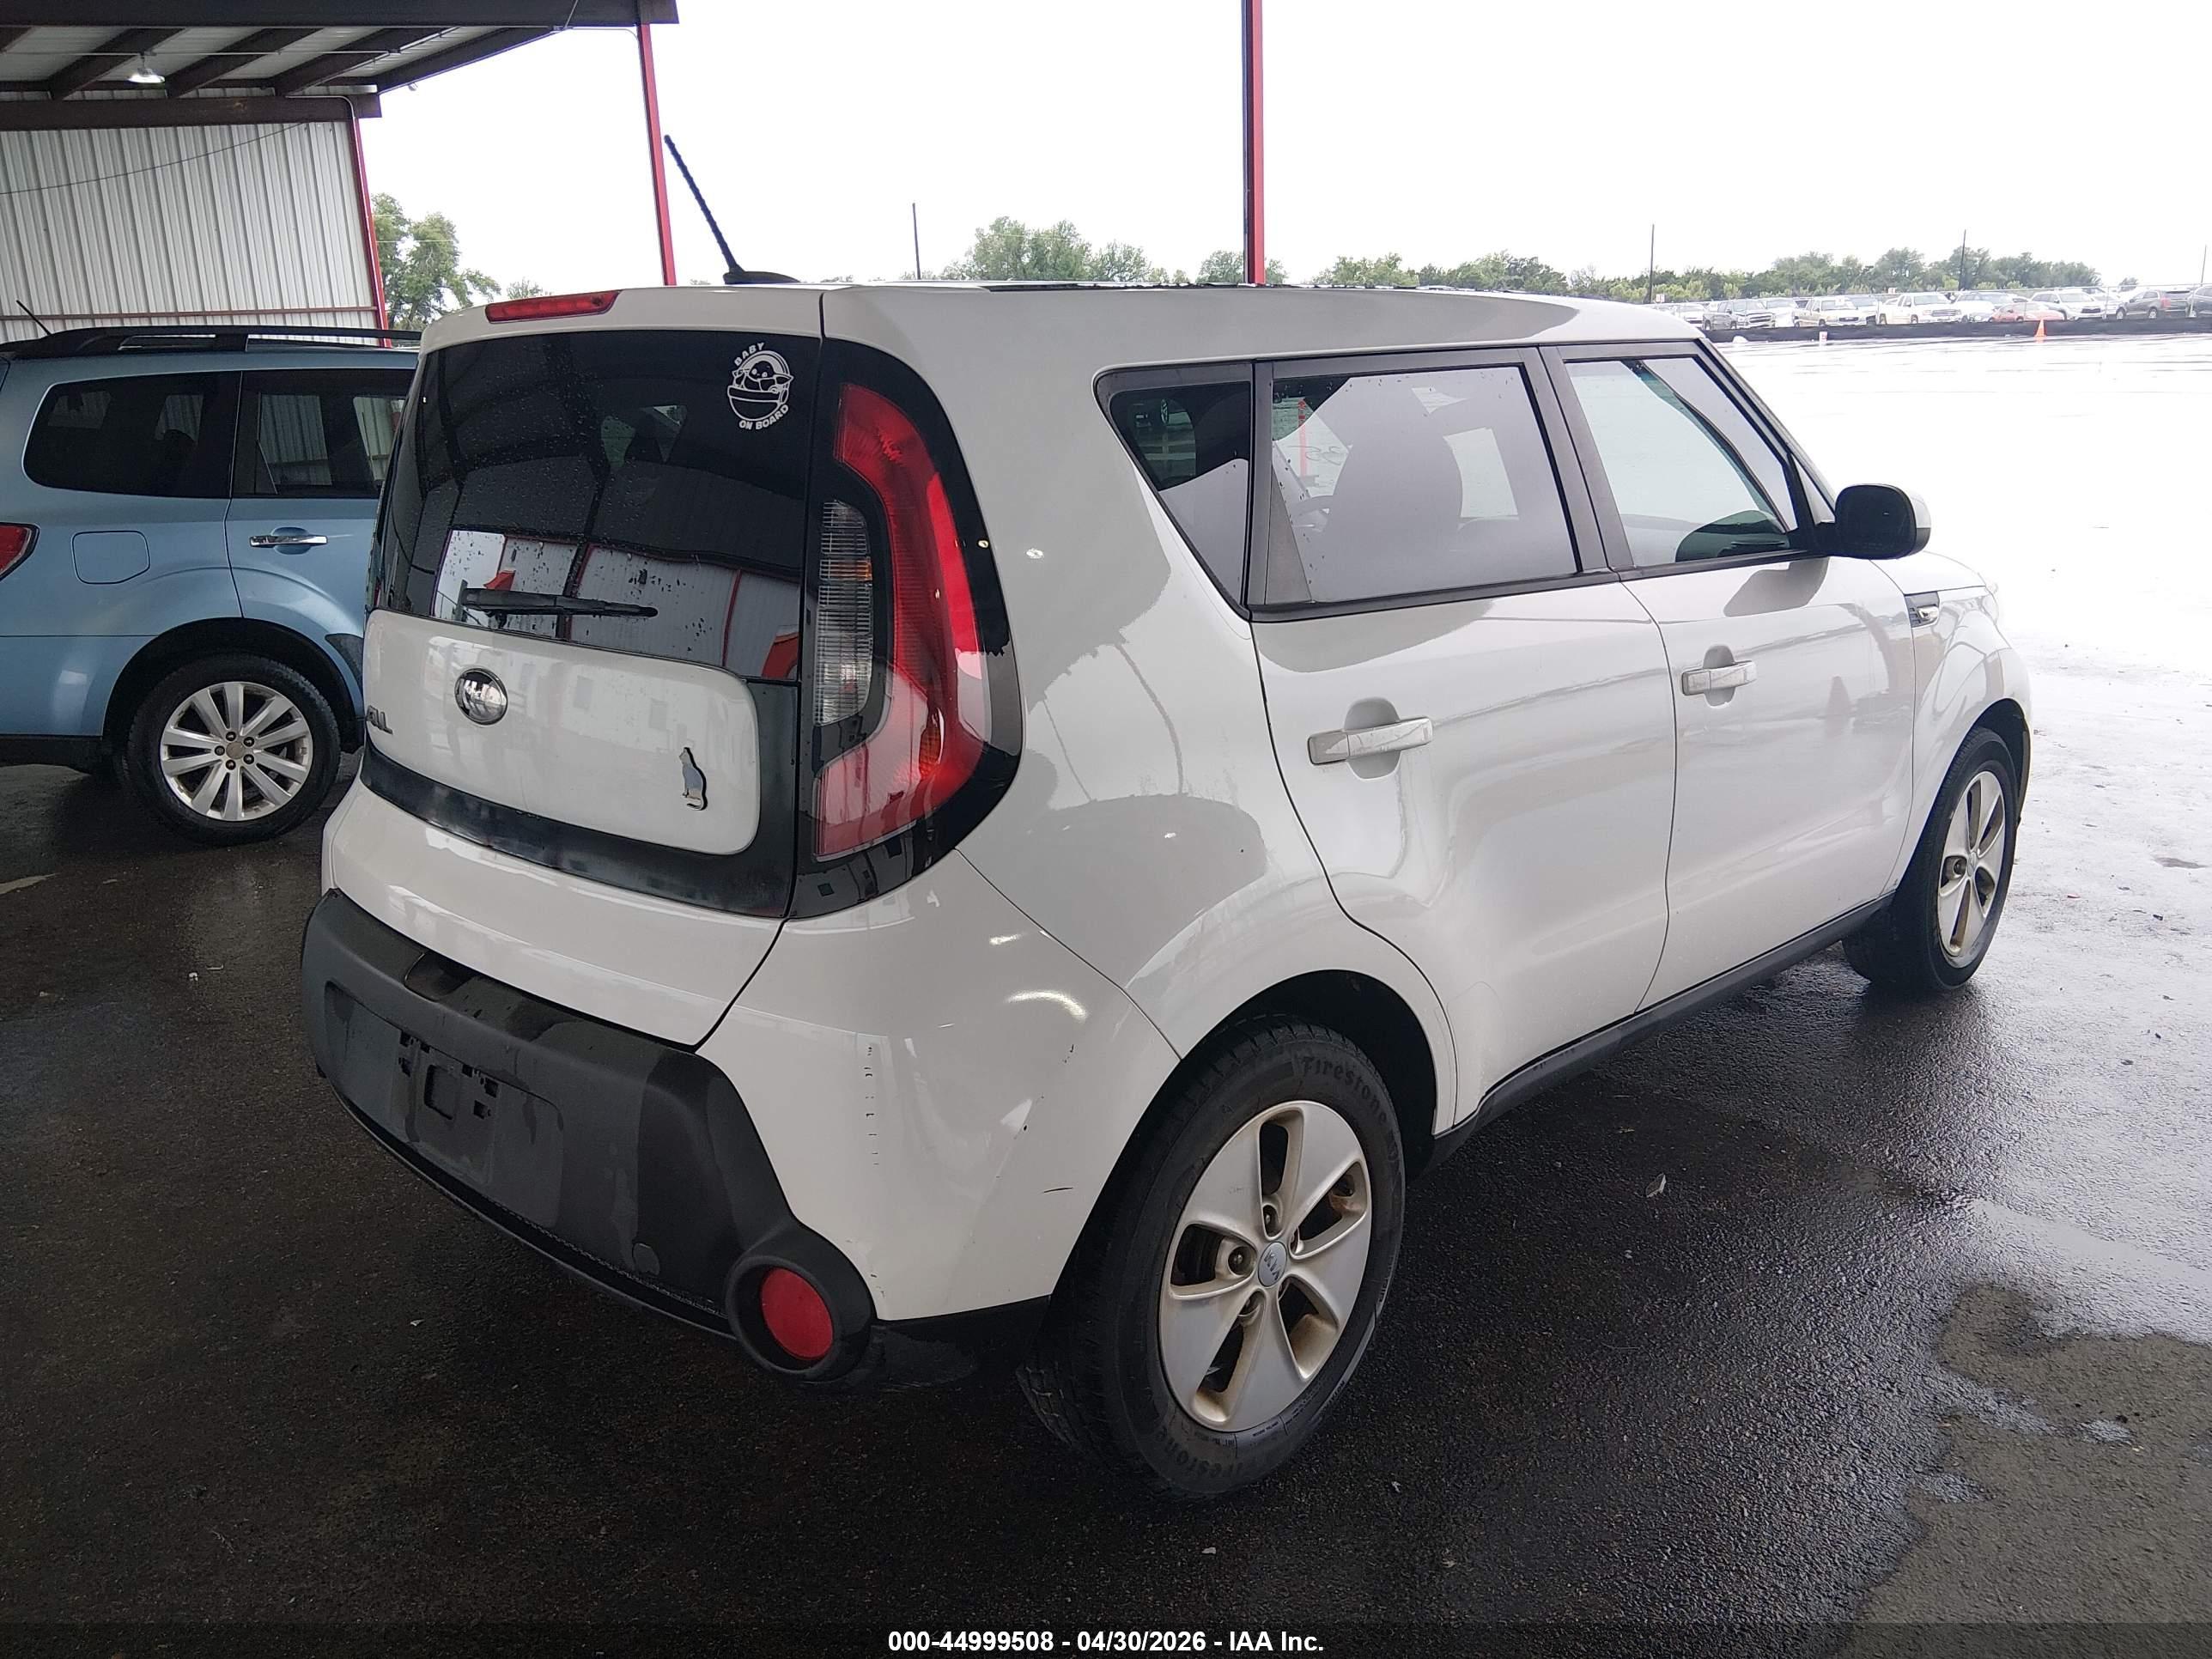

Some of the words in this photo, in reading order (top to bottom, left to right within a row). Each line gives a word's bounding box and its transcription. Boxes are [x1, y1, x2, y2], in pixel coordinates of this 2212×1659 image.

[734, 342, 765, 367] BABY
[738, 420, 753, 430] ON
[756, 404, 789, 430] BOARD
[1301, 1054, 1387, 1123] Firestone
